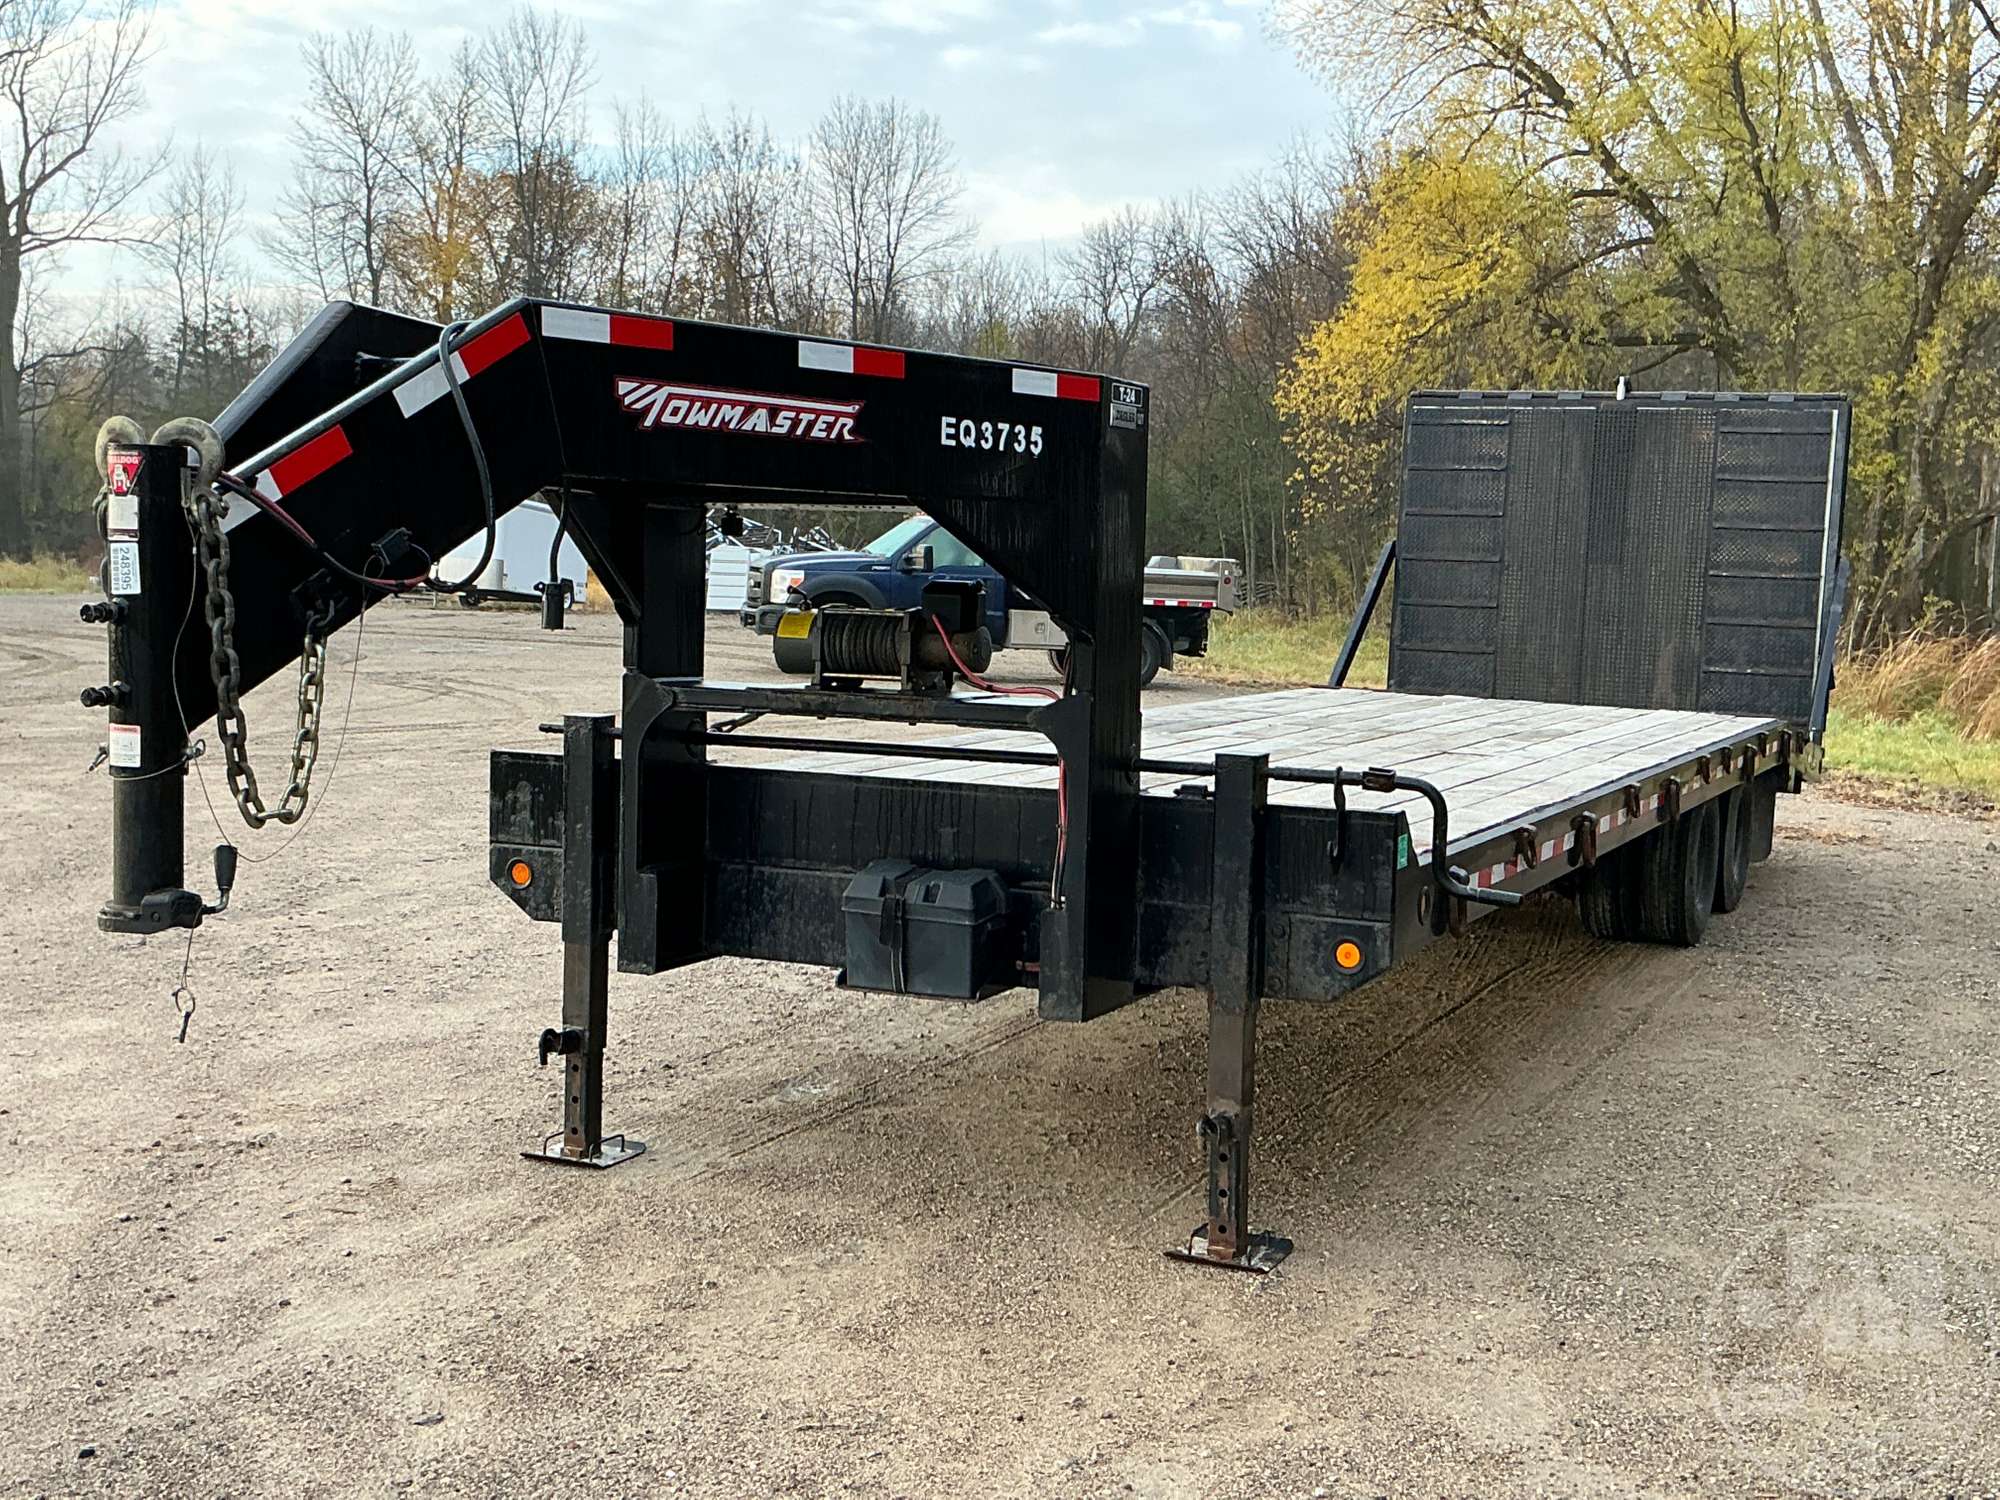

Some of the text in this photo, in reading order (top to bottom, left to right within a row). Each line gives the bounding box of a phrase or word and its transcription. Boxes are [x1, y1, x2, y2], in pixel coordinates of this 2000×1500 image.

[617, 380, 861, 441] TOWMASTER
[1119, 387, 1136, 404] T-24
[941, 416, 1043, 458] EQ3735
[119, 547, 132, 591] 248395
